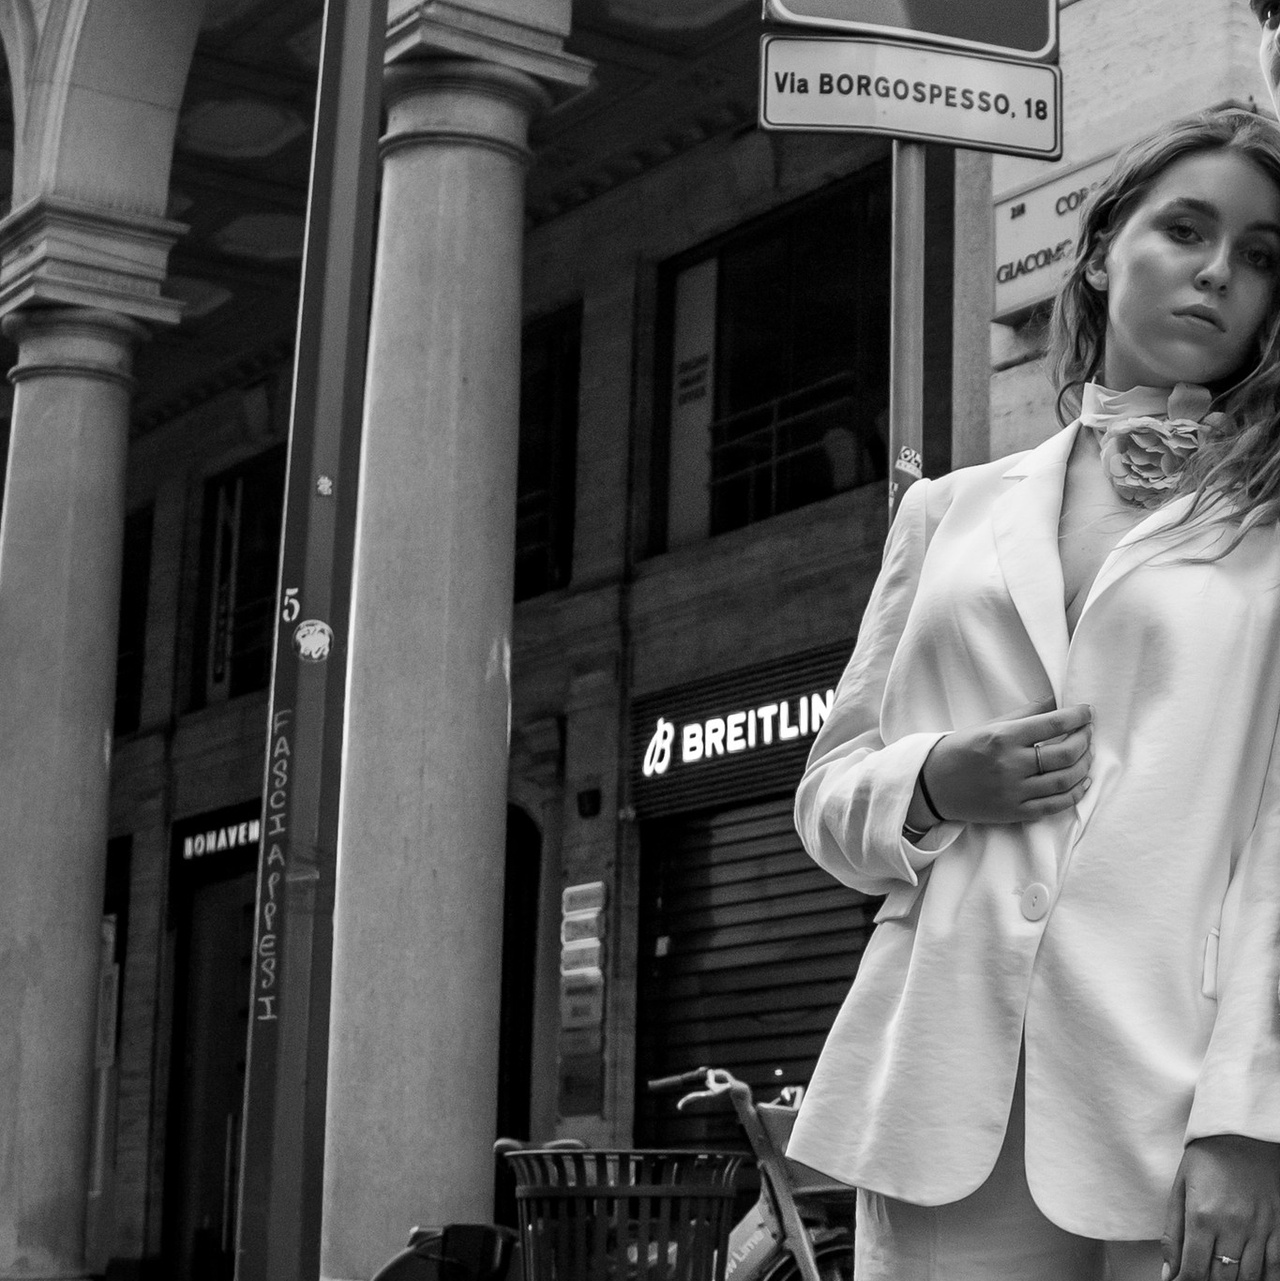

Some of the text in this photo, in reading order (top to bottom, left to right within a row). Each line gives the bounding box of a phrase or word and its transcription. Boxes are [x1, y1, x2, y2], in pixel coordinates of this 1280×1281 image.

[775, 72, 1048, 120] Via BORGOSPESSO, 18
[281, 587, 300, 621] 5
